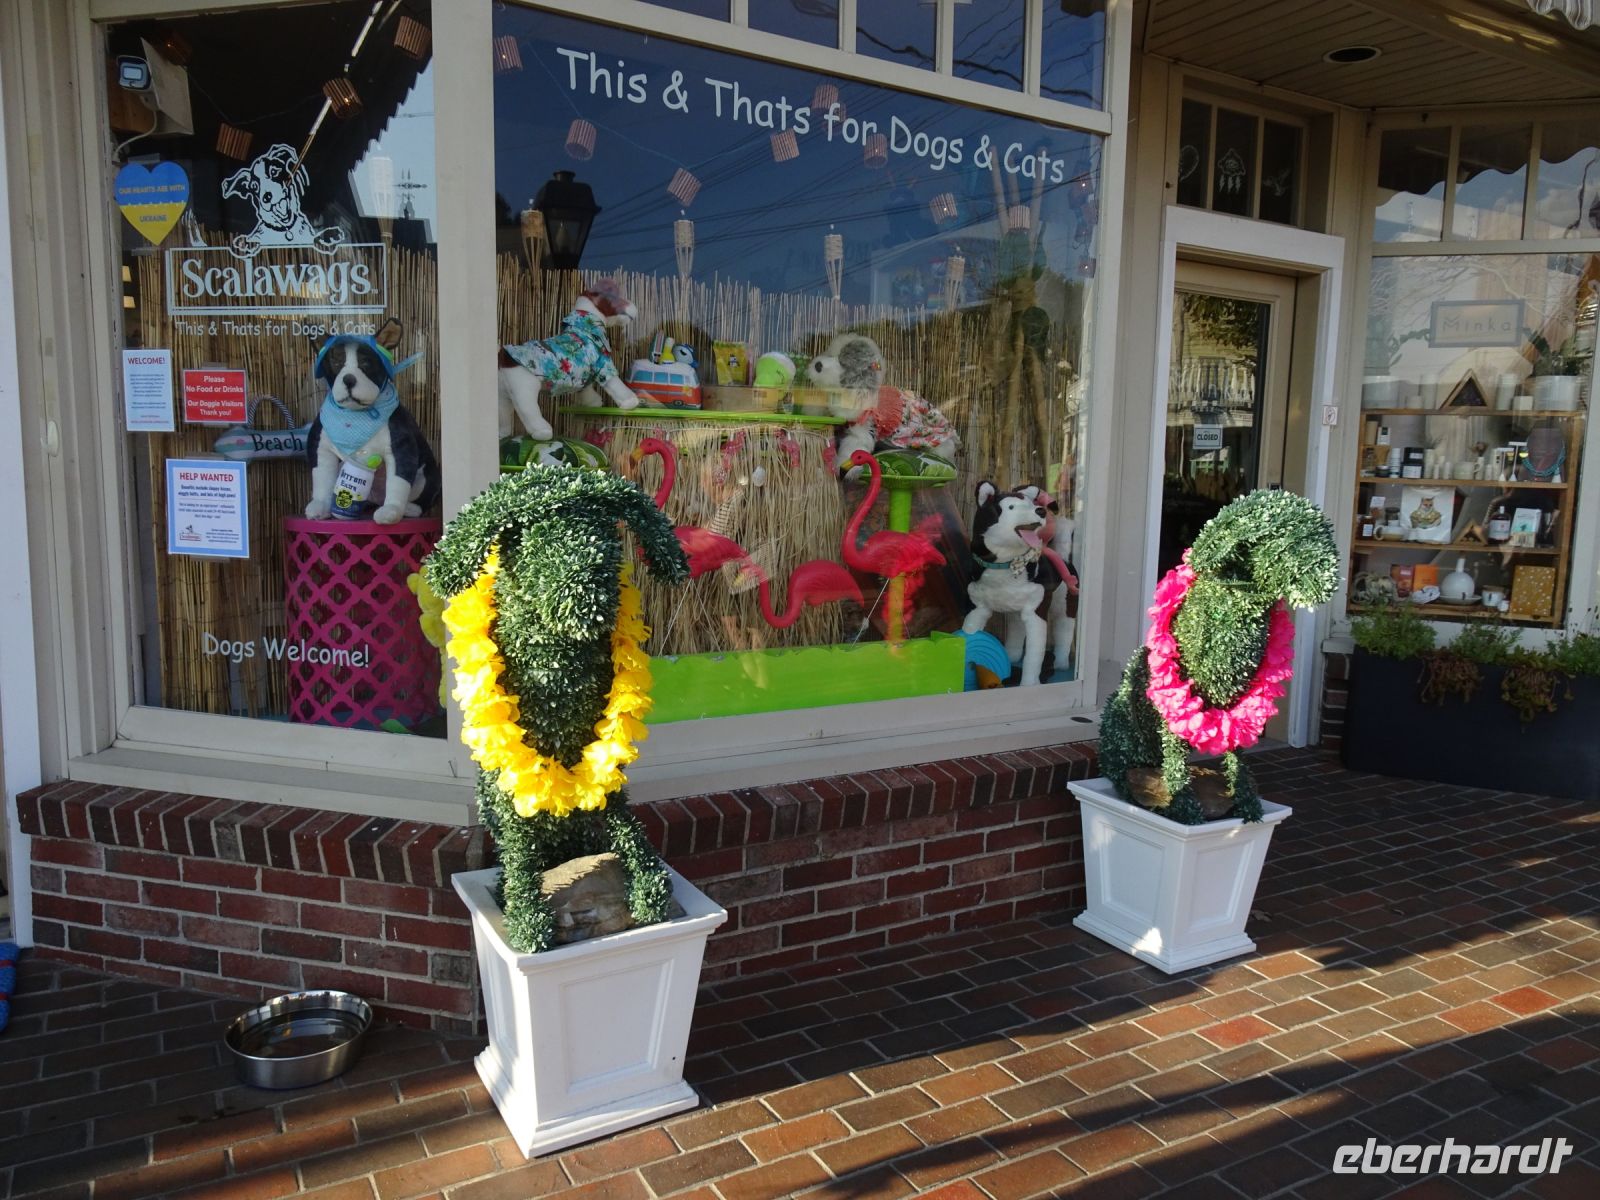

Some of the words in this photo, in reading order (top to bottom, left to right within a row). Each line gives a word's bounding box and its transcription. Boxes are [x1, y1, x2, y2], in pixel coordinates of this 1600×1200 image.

[556, 47, 648, 104] This
[662, 70, 689, 113] &
[704, 77, 811, 134] Thats
[823, 102, 877, 146] for
[890, 115, 964, 171] Dogs
[974, 134, 993, 170] &
[1003, 142, 1065, 184] Cats
[139, 214, 168, 222] UKRAINE
[182, 256, 372, 305] Scalawags
[1443, 317, 1512, 332] Minka
[176, 321, 204, 336] This
[208, 321, 218, 336] &
[222, 321, 261, 336] Thats
[265, 321, 287, 336] for
[292, 321, 325, 340] Dogs
[330, 321, 340, 336] &
[344, 321, 376, 336] Cats
[128, 356, 166, 365] WELCOME!
[203, 375, 225, 383] Please
[196, 385, 213, 393] Food
[222, 385, 244, 393] Drinks
[200, 400, 220, 409] Doggie
[219, 409, 232, 417] you!
[248, 431, 304, 452] Beach
[1196, 433, 1219, 441] CLOSED
[179, 472, 198, 481] HELP
[199, 473, 234, 482] WANTED
[202, 631, 255, 663] Dogs
[263, 636, 369, 668] Welcome!
